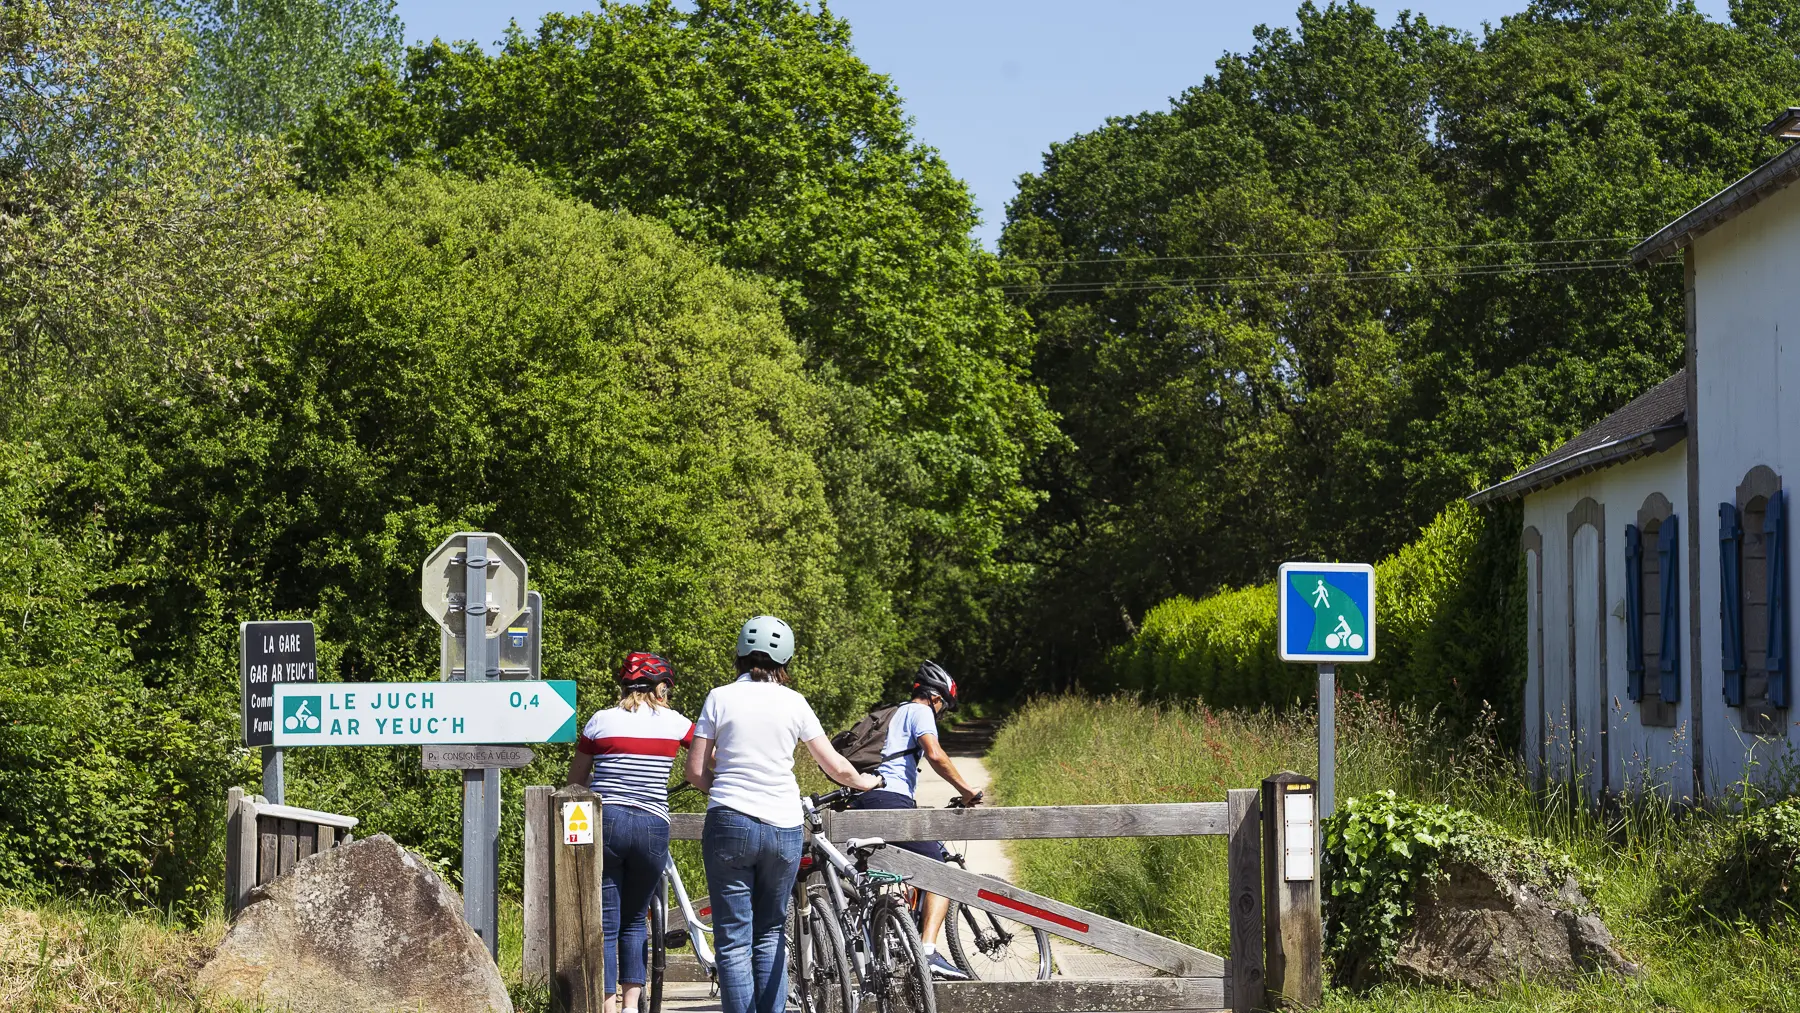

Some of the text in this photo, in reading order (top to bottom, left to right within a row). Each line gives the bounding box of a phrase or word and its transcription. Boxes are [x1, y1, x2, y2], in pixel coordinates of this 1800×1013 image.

[263, 634, 301, 654] LA GARE
[250, 664, 268, 684] GAR
[271, 663, 283, 682] AR
[329, 691, 540, 711] LE JUCH 0,4
[330, 718, 360, 735] AR
[442, 751, 488, 761] CONSIGNES
[487, 750, 494, 760] À
[496, 750, 521, 760] VÉLOS
